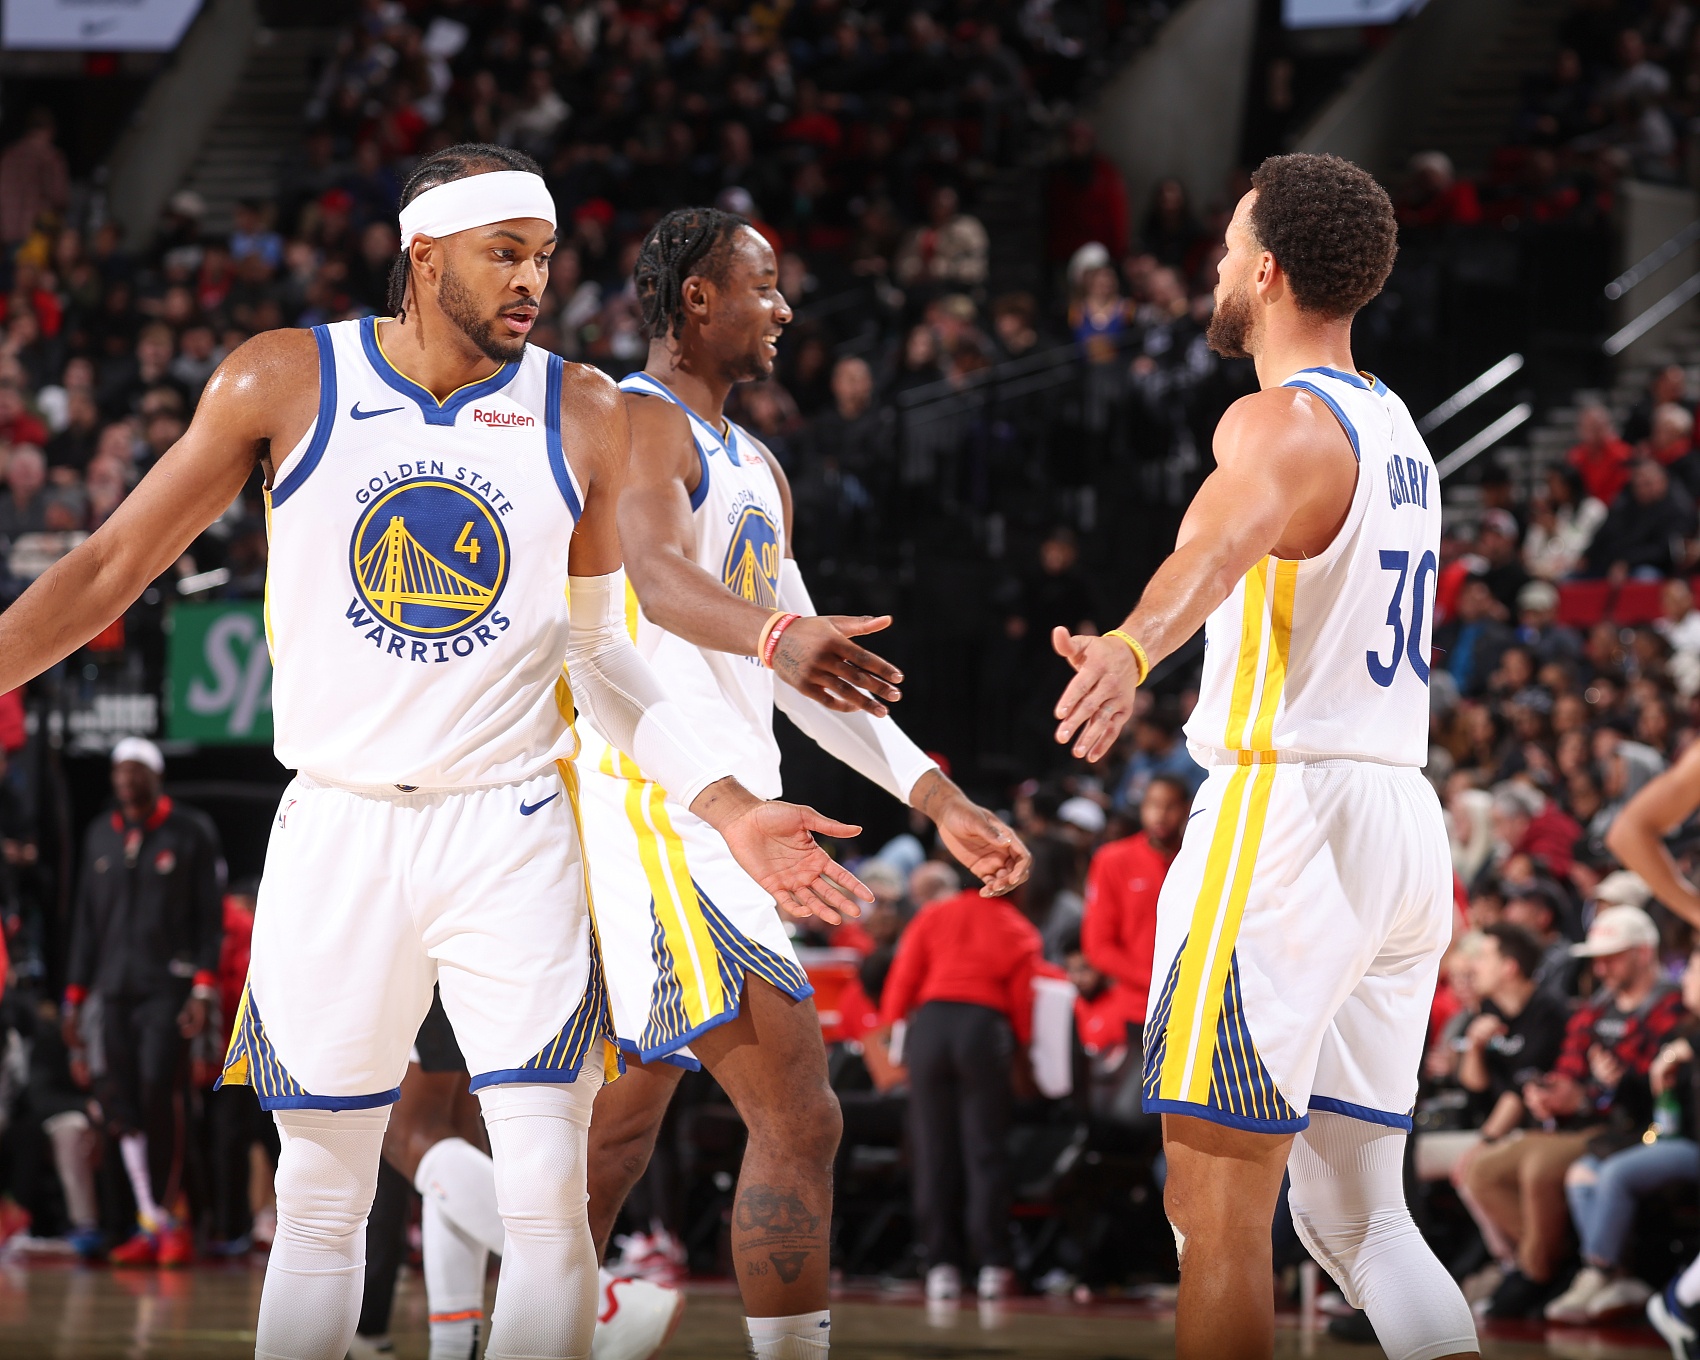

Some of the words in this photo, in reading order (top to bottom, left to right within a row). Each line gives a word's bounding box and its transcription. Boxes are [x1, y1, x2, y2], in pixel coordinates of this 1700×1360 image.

[473, 408, 535, 428] Rakuten
[355, 460, 444, 504] GOLDEN
[455, 466, 514, 516] STATE
[1386, 454, 1429, 510] CURRY
[727, 488, 755, 525] GOLDEN
[454, 521, 481, 564] 4
[761, 541, 779, 580] 00
[345, 597, 511, 664] WARRIORS
[1366, 549, 1436, 688] 30
[747, 1261, 768, 1276] 243
